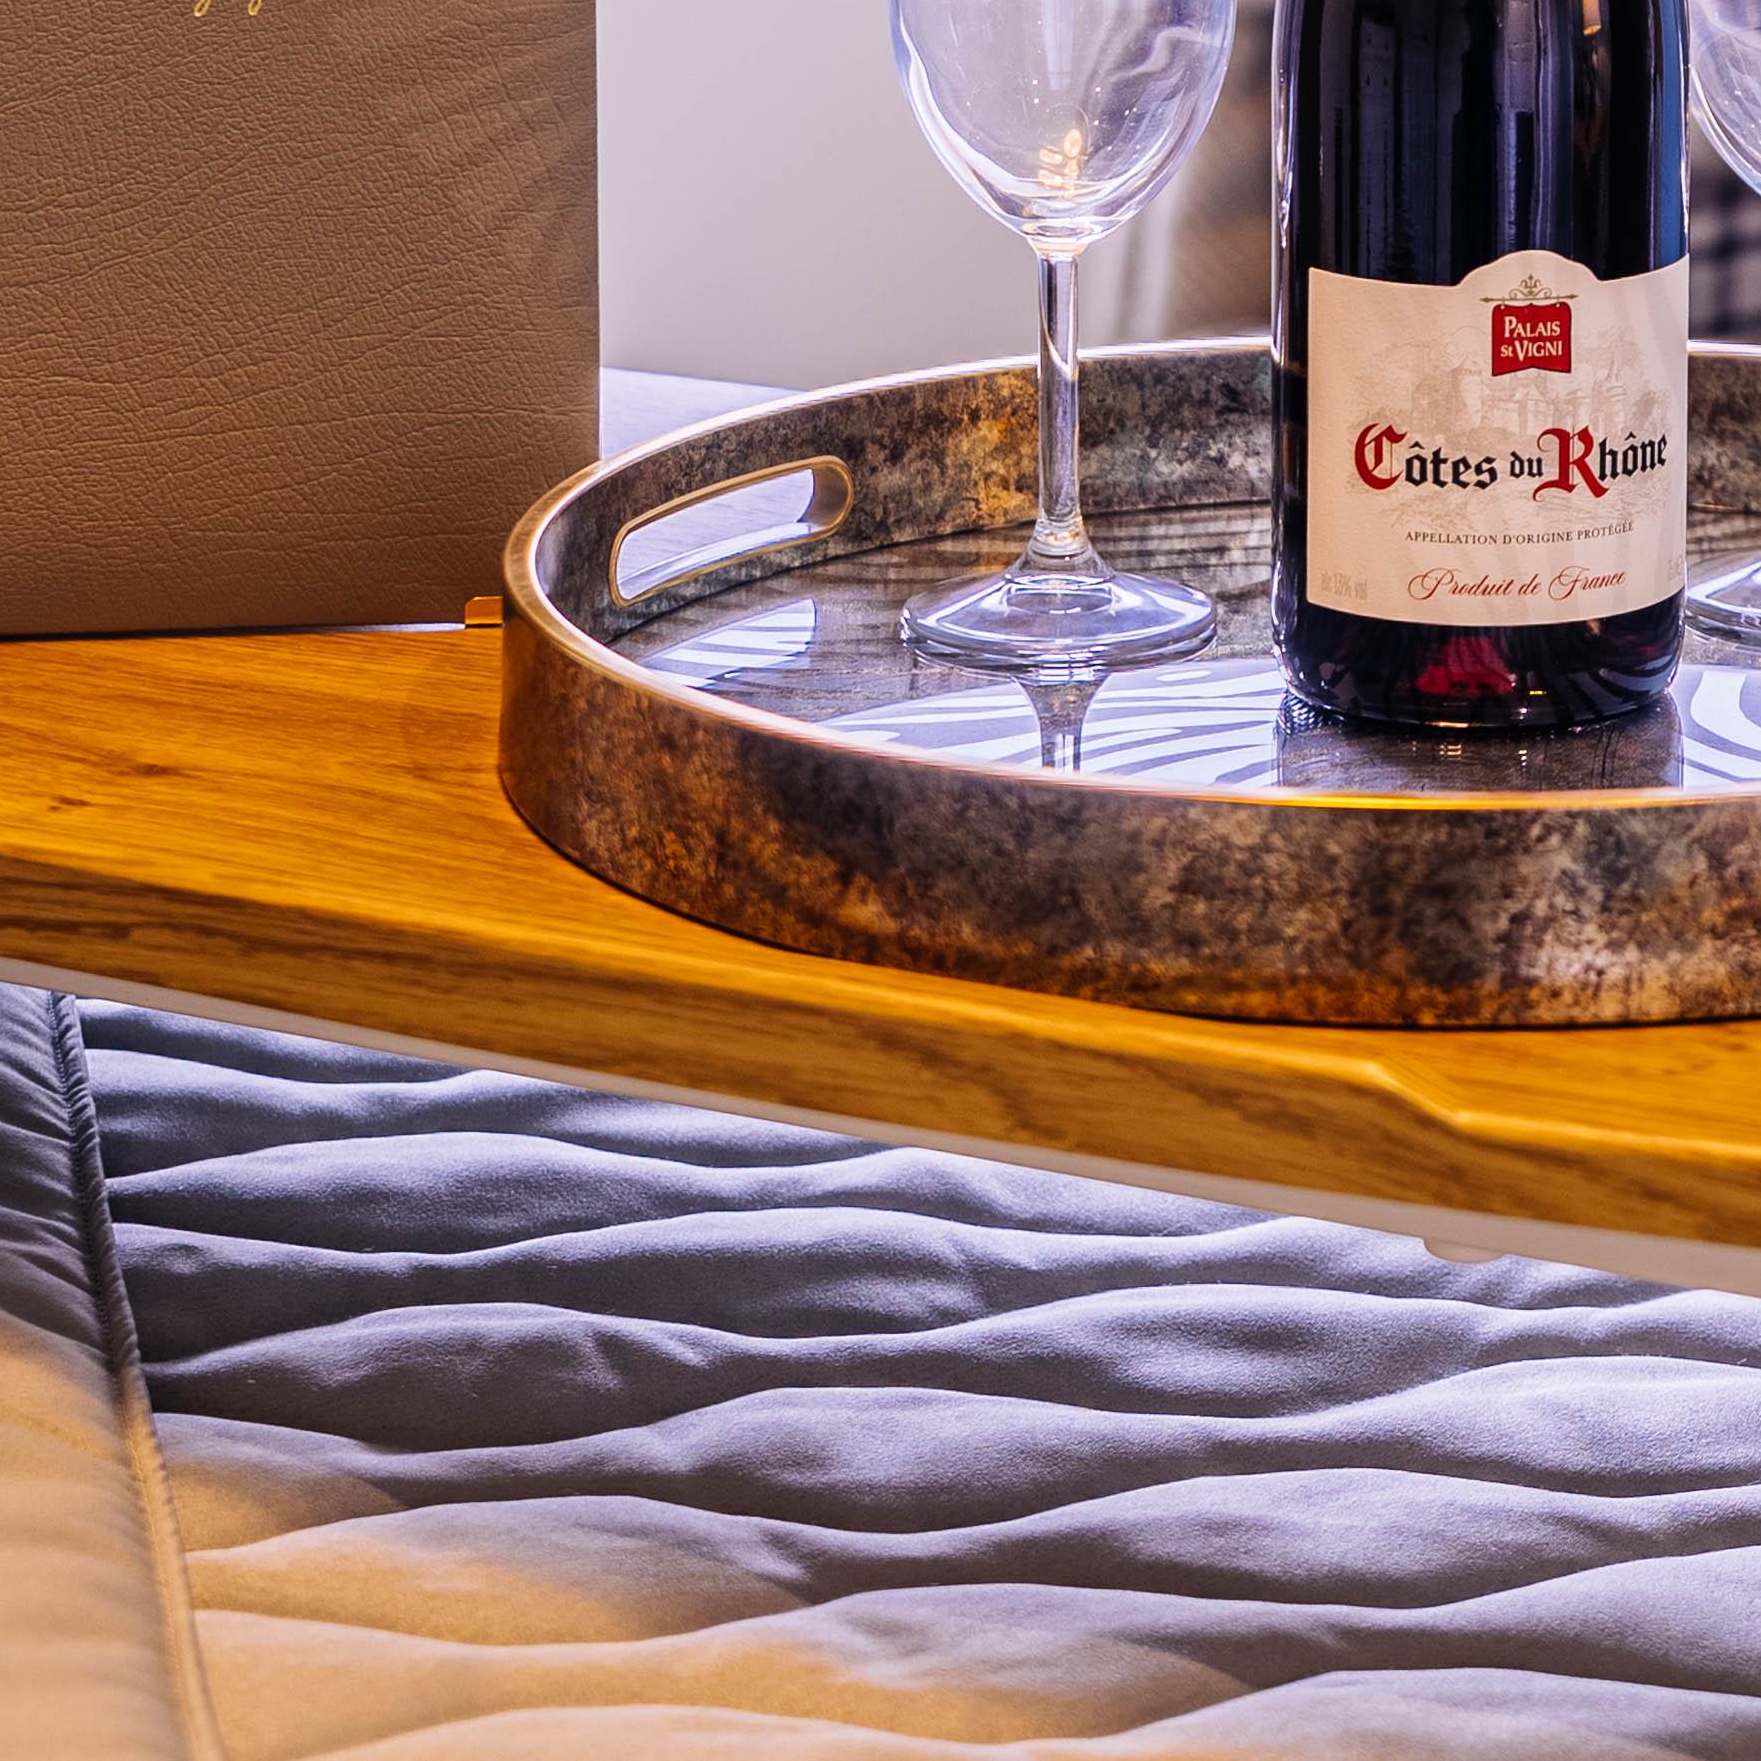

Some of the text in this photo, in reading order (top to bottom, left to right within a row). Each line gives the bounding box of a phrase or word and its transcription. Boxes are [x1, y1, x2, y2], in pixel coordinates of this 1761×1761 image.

[1504, 315, 1561, 338] PALAIS
[1514, 339, 1563, 362] VIGNI
[1354, 422, 1668, 502] Côtes du Rhône
[1405, 530, 1498, 545] APPELLATION
[1502, 529, 1573, 545] D'ORIGINE
[1407, 565, 1626, 601] Produit de France
